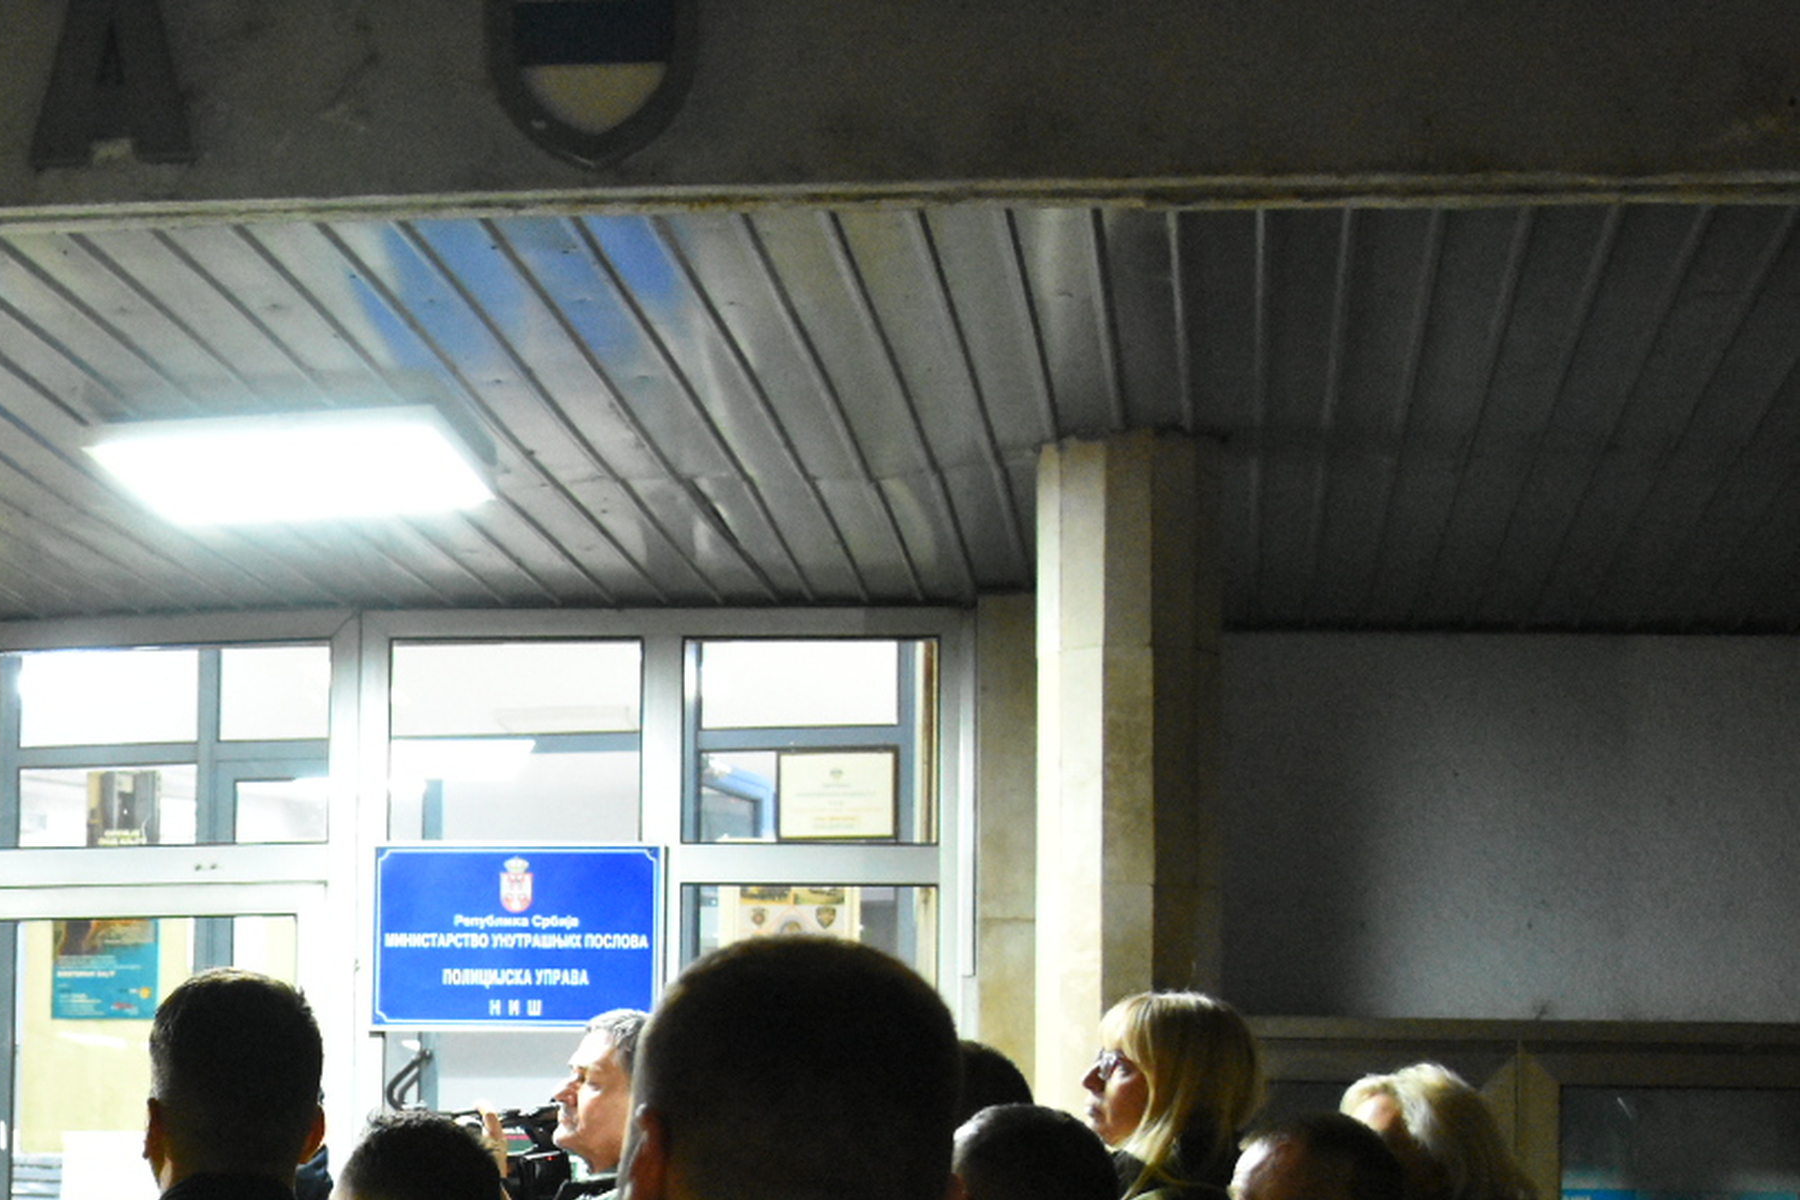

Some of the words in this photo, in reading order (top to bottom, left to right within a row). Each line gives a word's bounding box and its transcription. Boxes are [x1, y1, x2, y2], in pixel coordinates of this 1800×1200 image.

[453, 914, 529, 930] Република
[531, 914, 580, 930] Србија
[384, 932, 489, 949] МИНИСТАРСТВО
[490, 932, 583, 949] УНУТРАШЊИХ
[584, 932, 650, 949] ПОСЛОВА
[442, 968, 533, 989] ПОЛИЦИЈСКА
[535, 968, 590, 986] УПРАВА
